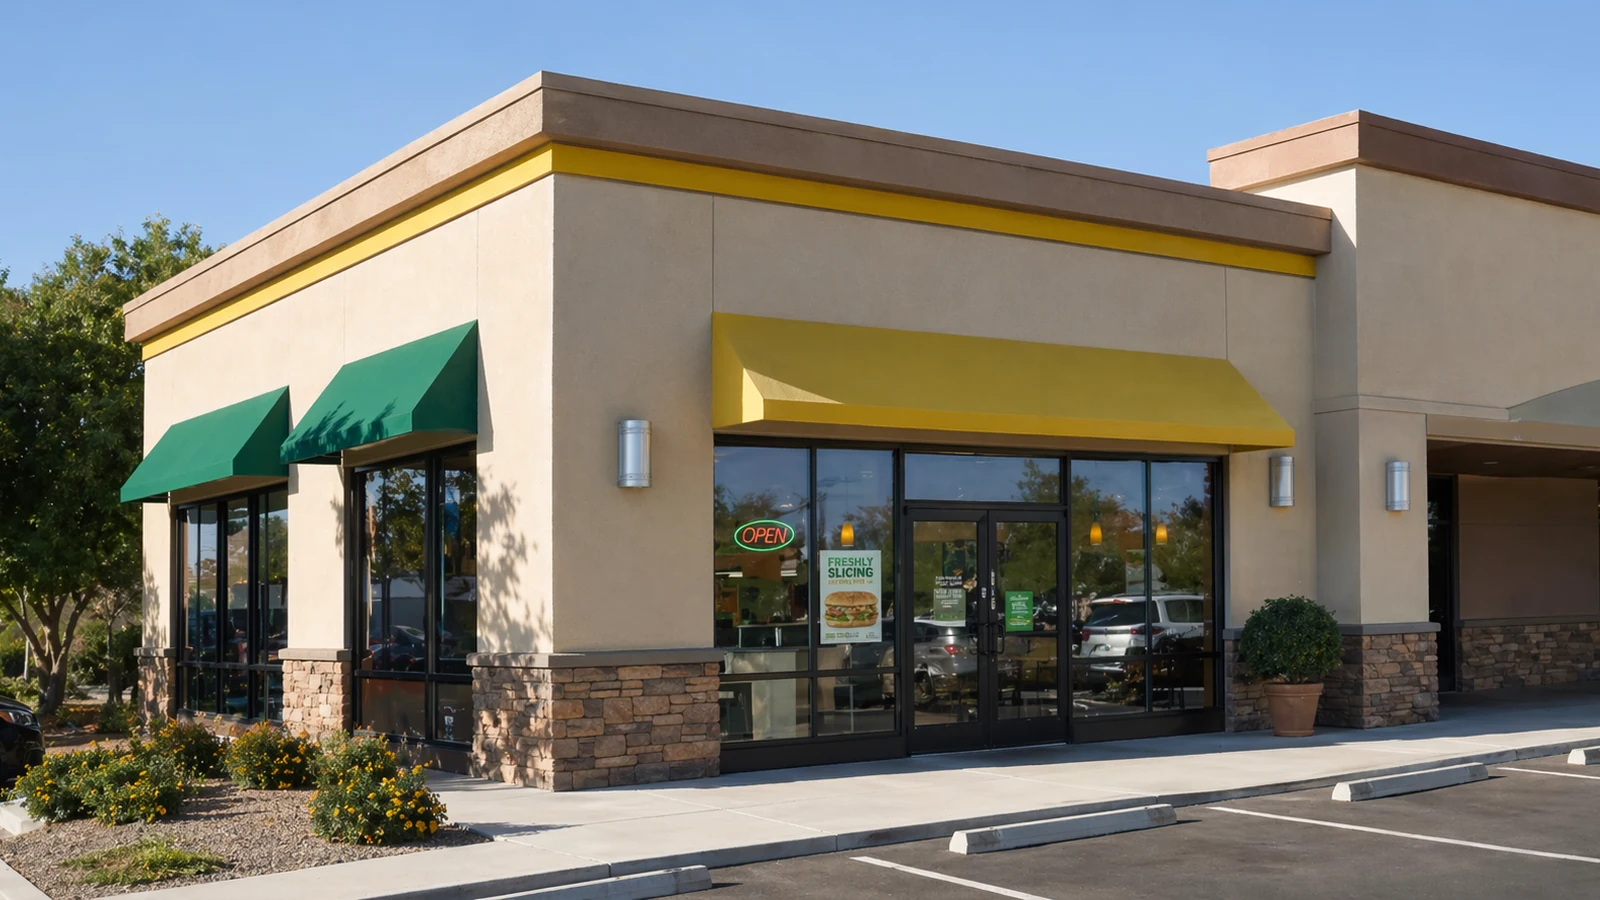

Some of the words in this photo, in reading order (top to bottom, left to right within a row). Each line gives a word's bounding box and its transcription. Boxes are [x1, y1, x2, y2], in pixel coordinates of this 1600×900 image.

[742, 526, 788, 544] OPEN
[828, 557, 874, 567] FRESHLY
[828, 567, 874, 578] SLICING
